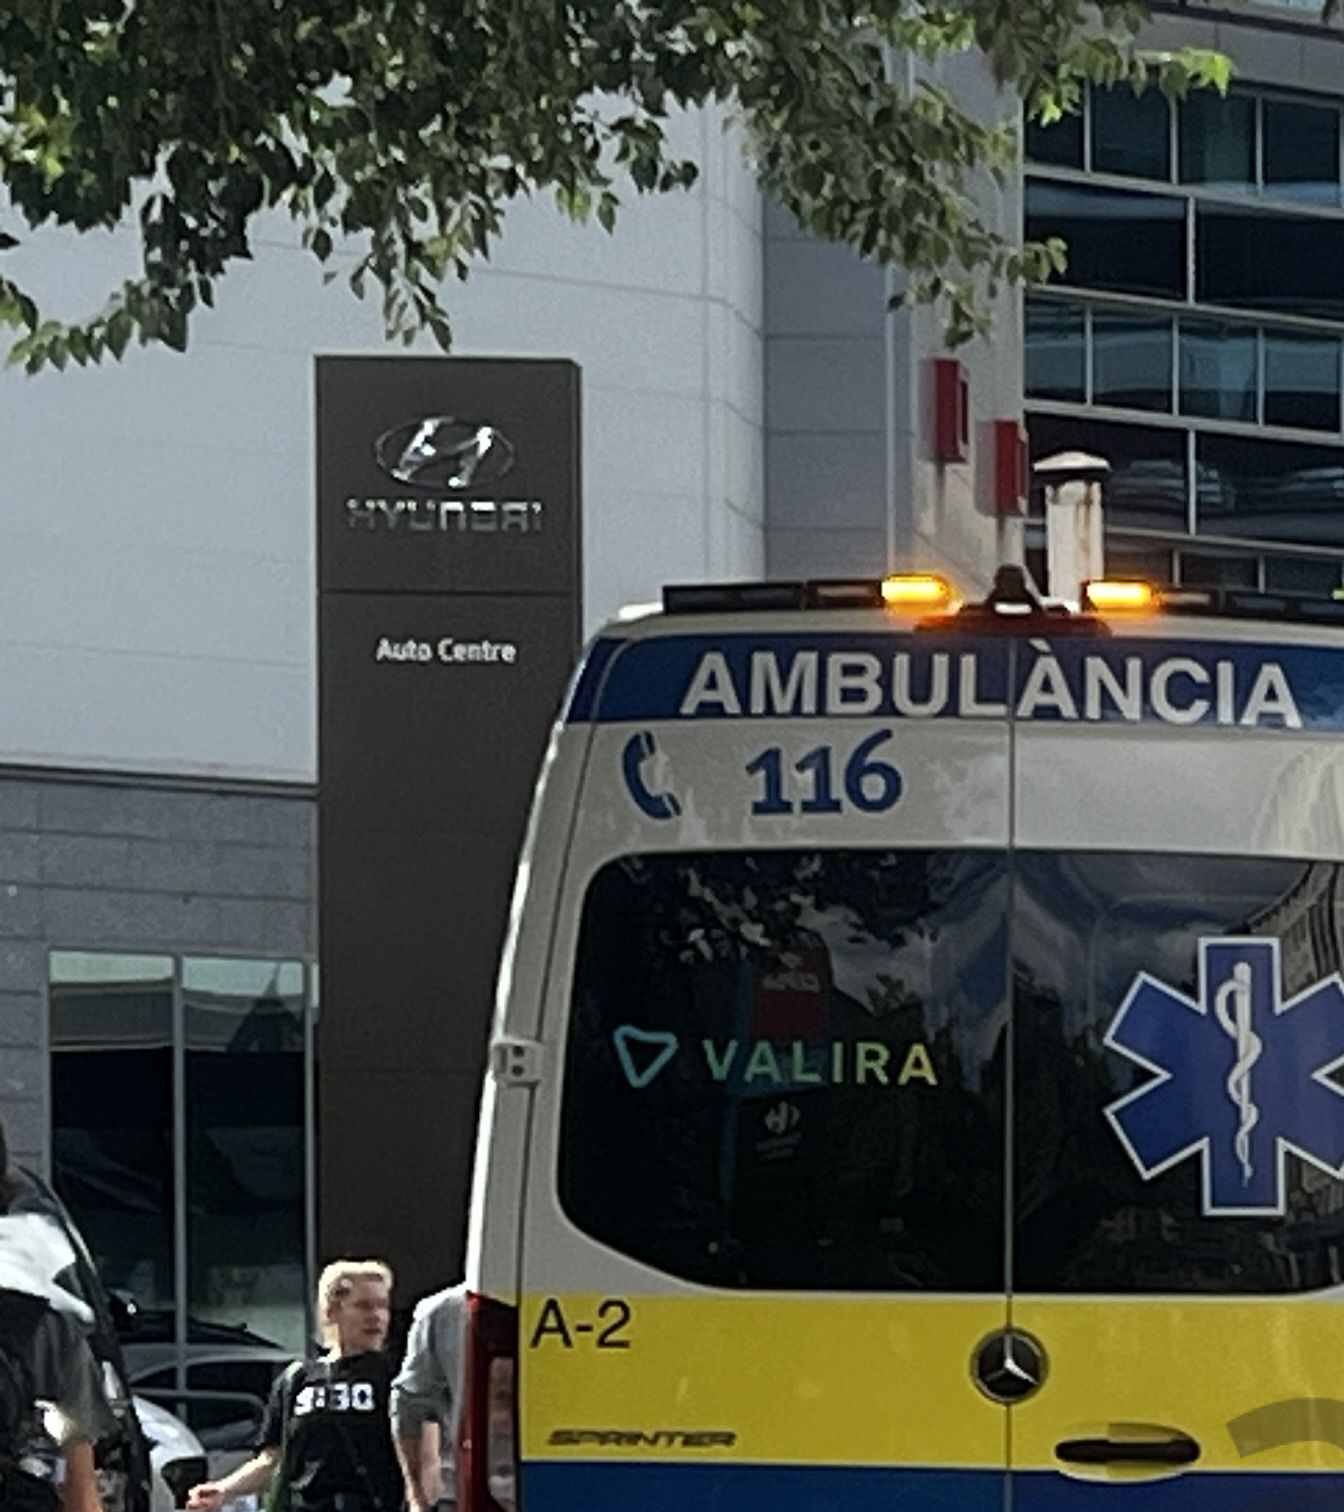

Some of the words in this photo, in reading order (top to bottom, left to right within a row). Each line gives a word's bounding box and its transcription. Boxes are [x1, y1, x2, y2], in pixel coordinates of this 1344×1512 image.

[346, 499, 543, 532] HYUNDAI
[377, 638, 432, 661] Auto
[438, 638, 516, 663] Centre
[679, 640, 1303, 729] AMBULÀNCIA
[746, 729, 904, 816] 116
[702, 1039, 939, 1086] VALIRA
[530, 1298, 631, 1348] A-2
[548, 1429, 737, 1447] SPRINTER
